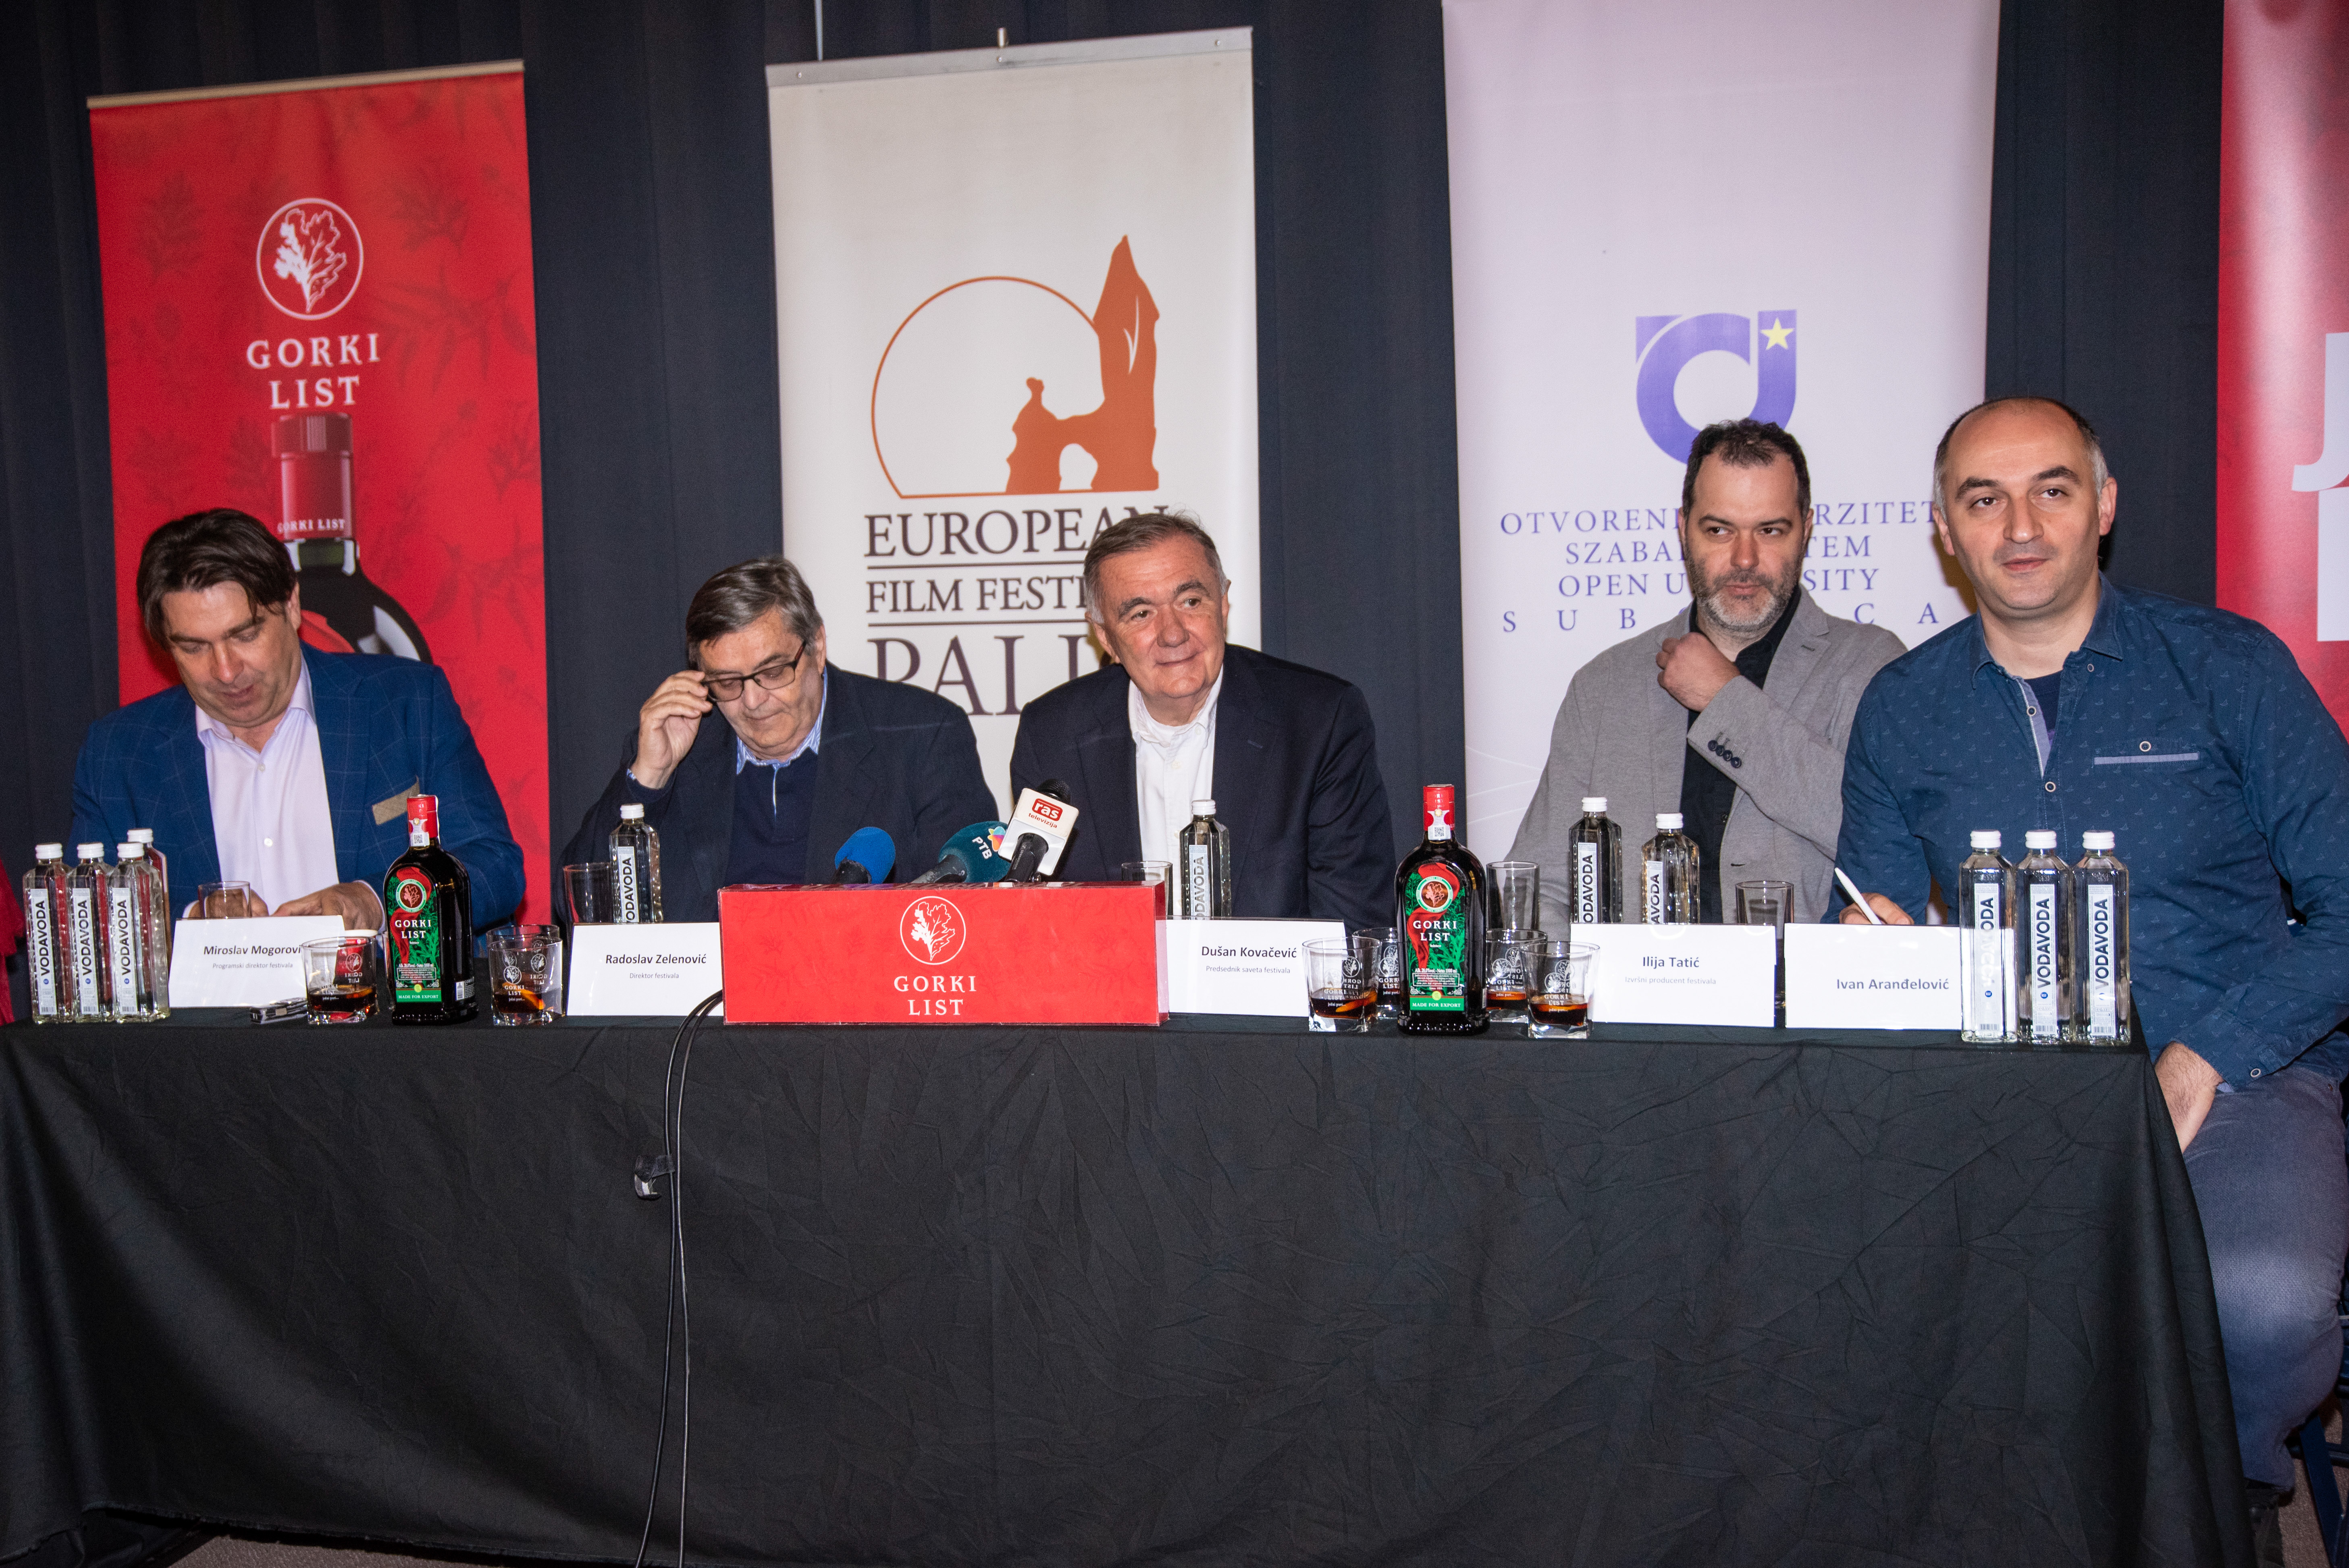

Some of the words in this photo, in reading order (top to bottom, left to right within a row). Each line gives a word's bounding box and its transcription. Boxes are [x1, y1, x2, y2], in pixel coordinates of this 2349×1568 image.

[246, 333, 380, 369] GORKI
[269, 375, 359, 409] LIST
[318, 519, 345, 531] LIST
[864, 505, 1169, 557] EUROPEA
[866, 579, 963, 613] FILM
[977, 575, 1087, 611] FESTI
[1559, 574, 1648, 597] OPEN
[867, 634, 1088, 716] PALI
[1028, 813, 1057, 829] televizija
[1034, 802, 1060, 819] ras
[622, 857, 635, 922] ODAVODA
[1582, 855, 1594, 923] ODAVODA
[1413, 920, 1457, 929] GORKI
[35, 900, 50, 976] VODAVODA
[77, 899, 92, 976] VODAVODA
[117, 899, 131, 975] VODAVODA
[1420, 933, 1450, 941] LIST
[2036, 898, 2051, 989] VODAVODA
[2094, 898, 2109, 990] VODAVODA
[204, 945, 248, 955] Miroslav
[251, 945, 301, 956] Mogorovi
[606, 954, 653, 964] Radoslav
[655, 954, 707, 964] Zelenović
[1202, 946, 1236, 956] Dušan
[1240, 947, 1297, 957] Kovačević
[1643, 956, 1665, 969] Ilija
[1669, 957, 1699, 967] Tatić
[894, 976, 977, 993] GORKI
[1837, 979, 1864, 989] Ivan
[1869, 978, 1949, 989] Aranđelović
[908, 999, 963, 1016] LIST
